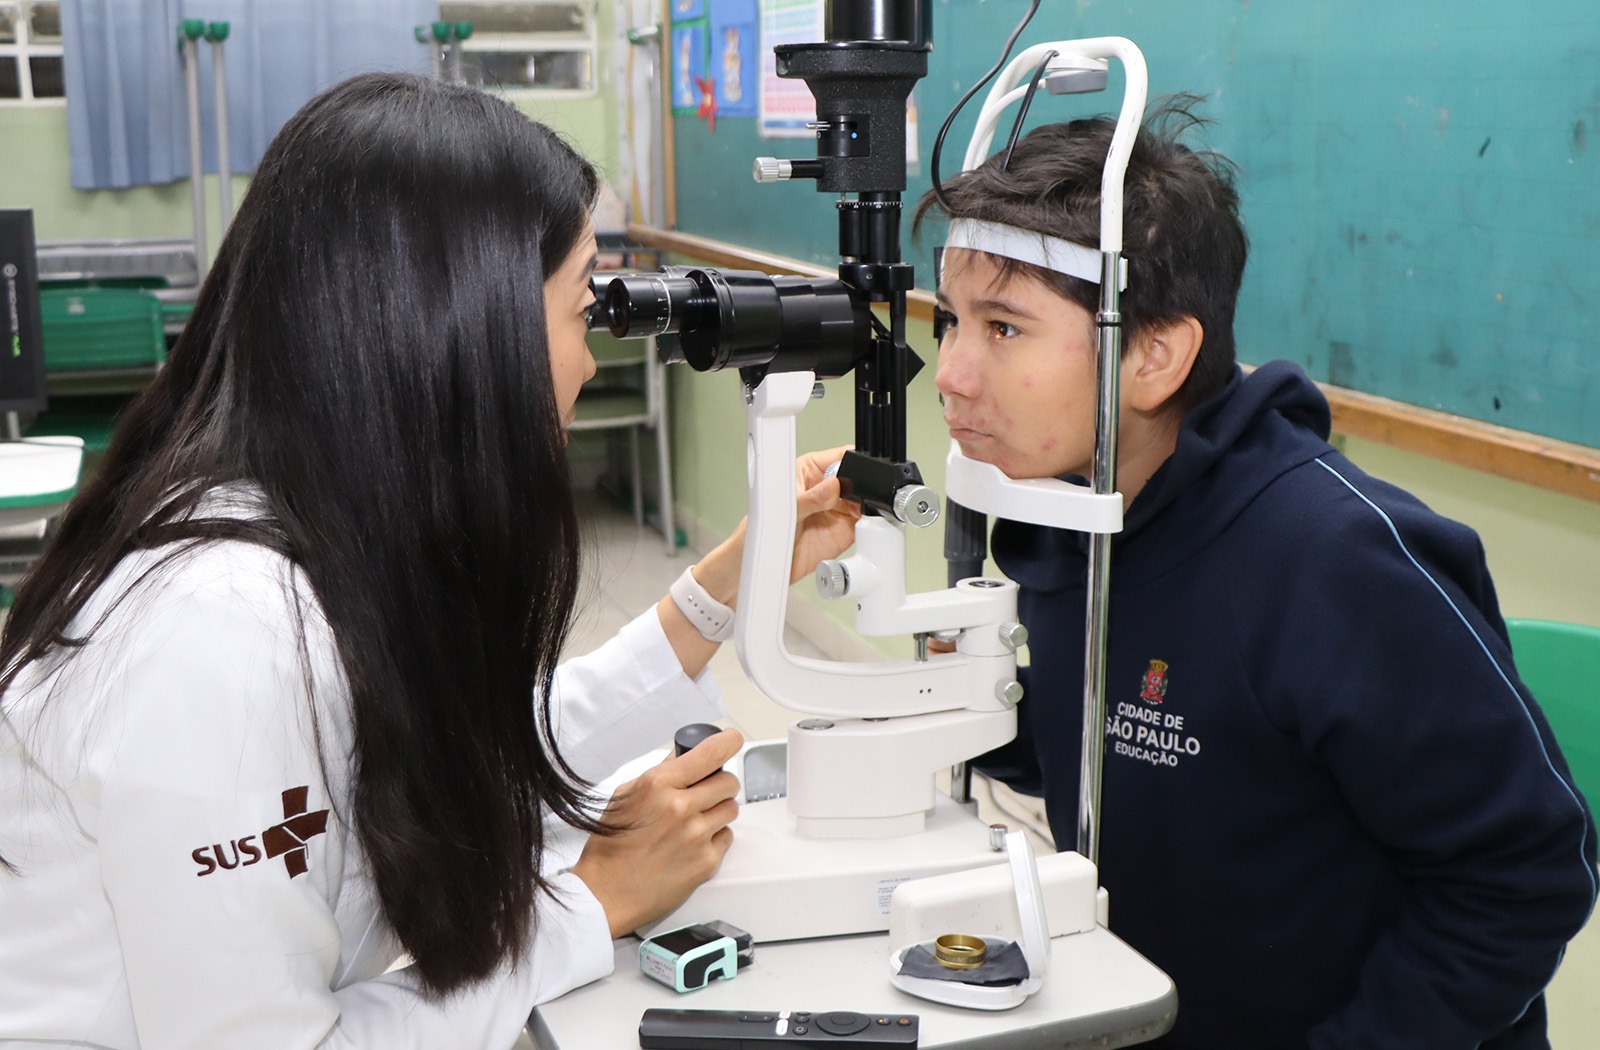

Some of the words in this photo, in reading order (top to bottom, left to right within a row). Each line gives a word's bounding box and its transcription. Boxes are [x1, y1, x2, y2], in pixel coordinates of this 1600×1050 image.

[1117, 701, 1161, 726] CIDADE
[1164, 713, 1185, 731] DE
[1115, 741, 1178, 767] EDUCAÇÃO
[1136, 725, 1201, 756] PAULO
[192, 835, 262, 877] SUS
